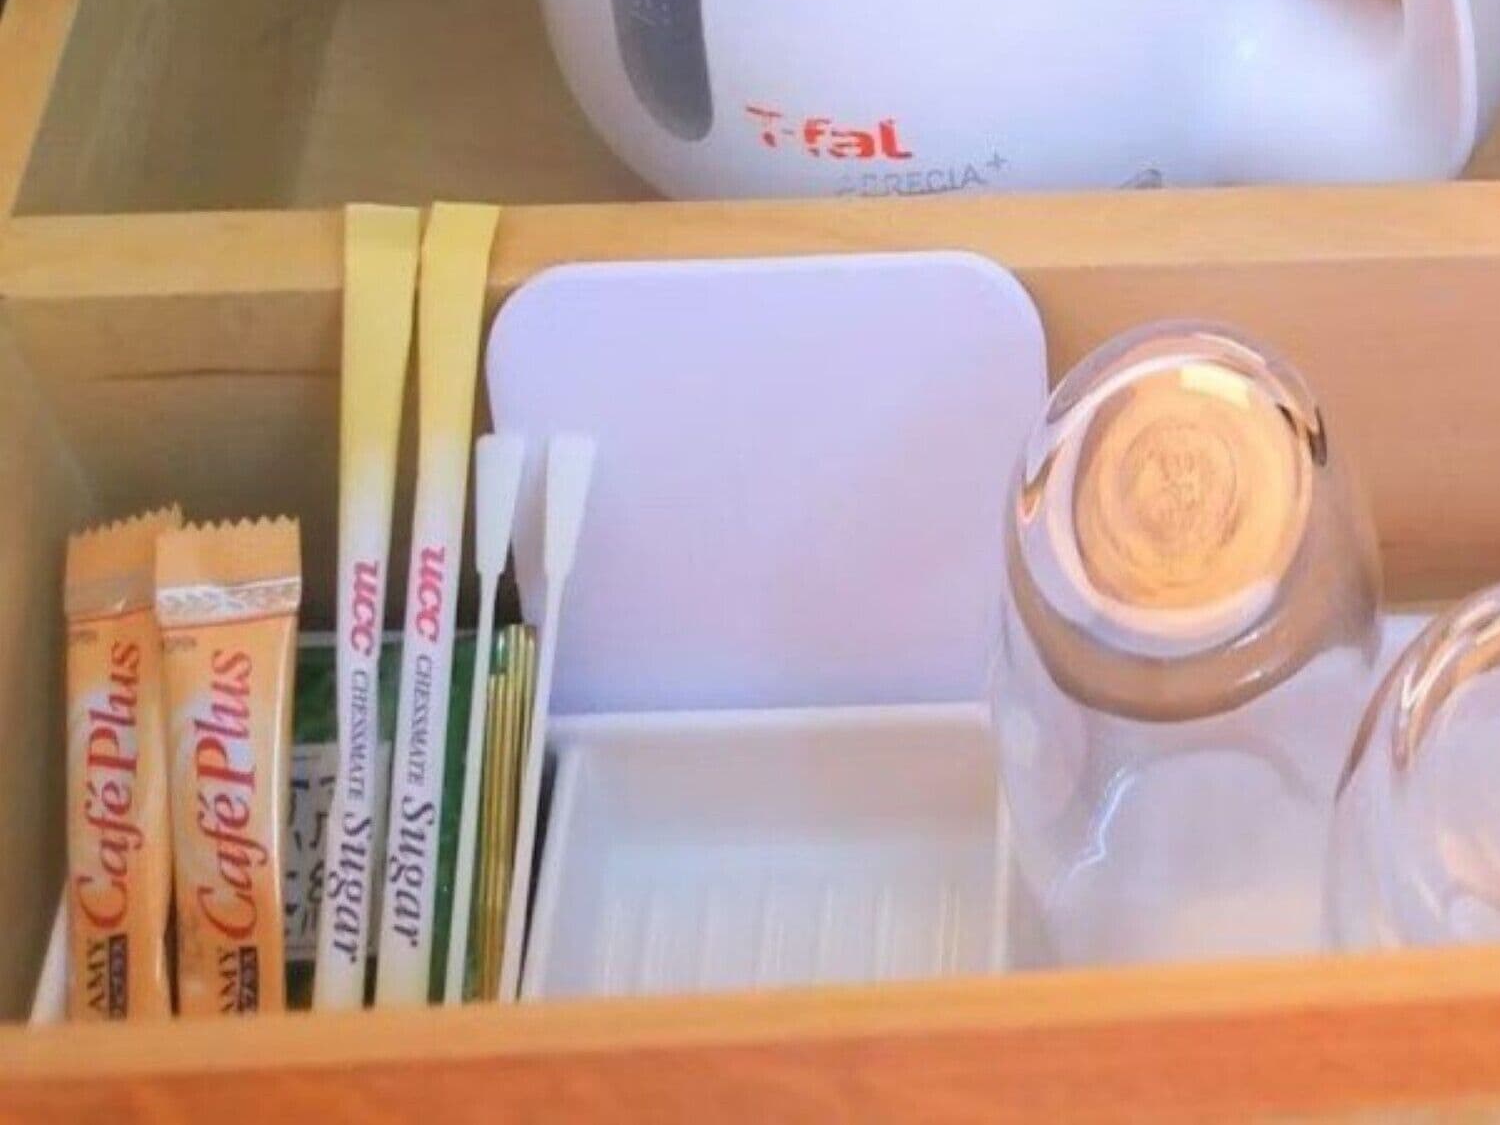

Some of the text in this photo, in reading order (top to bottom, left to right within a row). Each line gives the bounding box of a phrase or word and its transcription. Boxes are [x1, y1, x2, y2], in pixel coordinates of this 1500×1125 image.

[746, 104, 913, 160] T-fal
[329, 812, 373, 964] Sugar
[389, 795, 435, 948] Sugar
